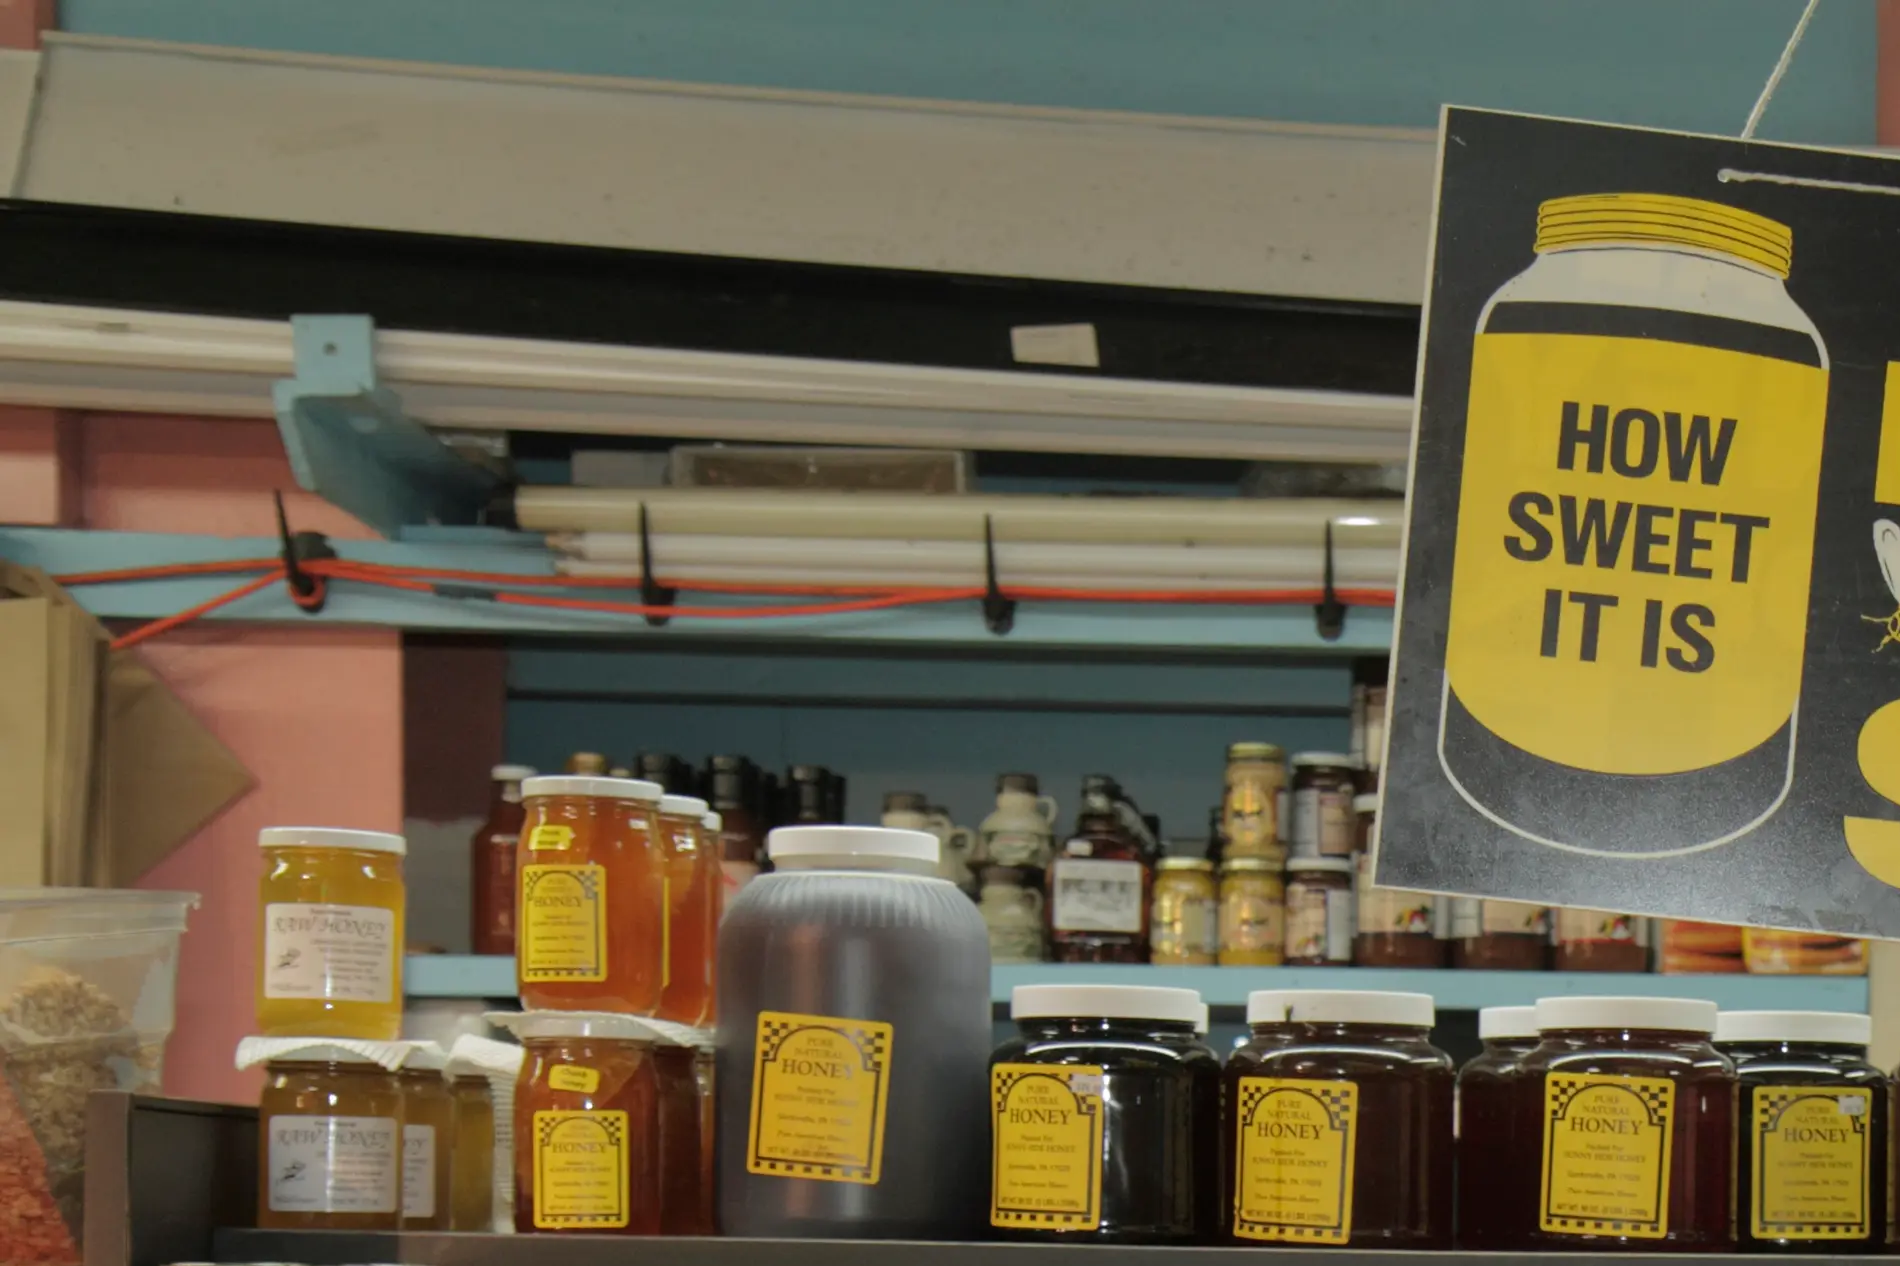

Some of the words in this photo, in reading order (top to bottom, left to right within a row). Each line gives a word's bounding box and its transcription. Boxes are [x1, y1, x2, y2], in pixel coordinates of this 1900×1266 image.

[1556, 401, 1737, 486] HOW
[1504, 490, 1770, 584] SWEET
[1540, 588, 1618, 662] IT
[1641, 597, 1716, 675] IS
[782, 1059, 853, 1079] HONEY
[1010, 1108, 1072, 1125] HONEY
[1570, 1116, 1644, 1136] HONEY
[1256, 1122, 1324, 1140] HONEY
[1784, 1127, 1849, 1143] HONEY
